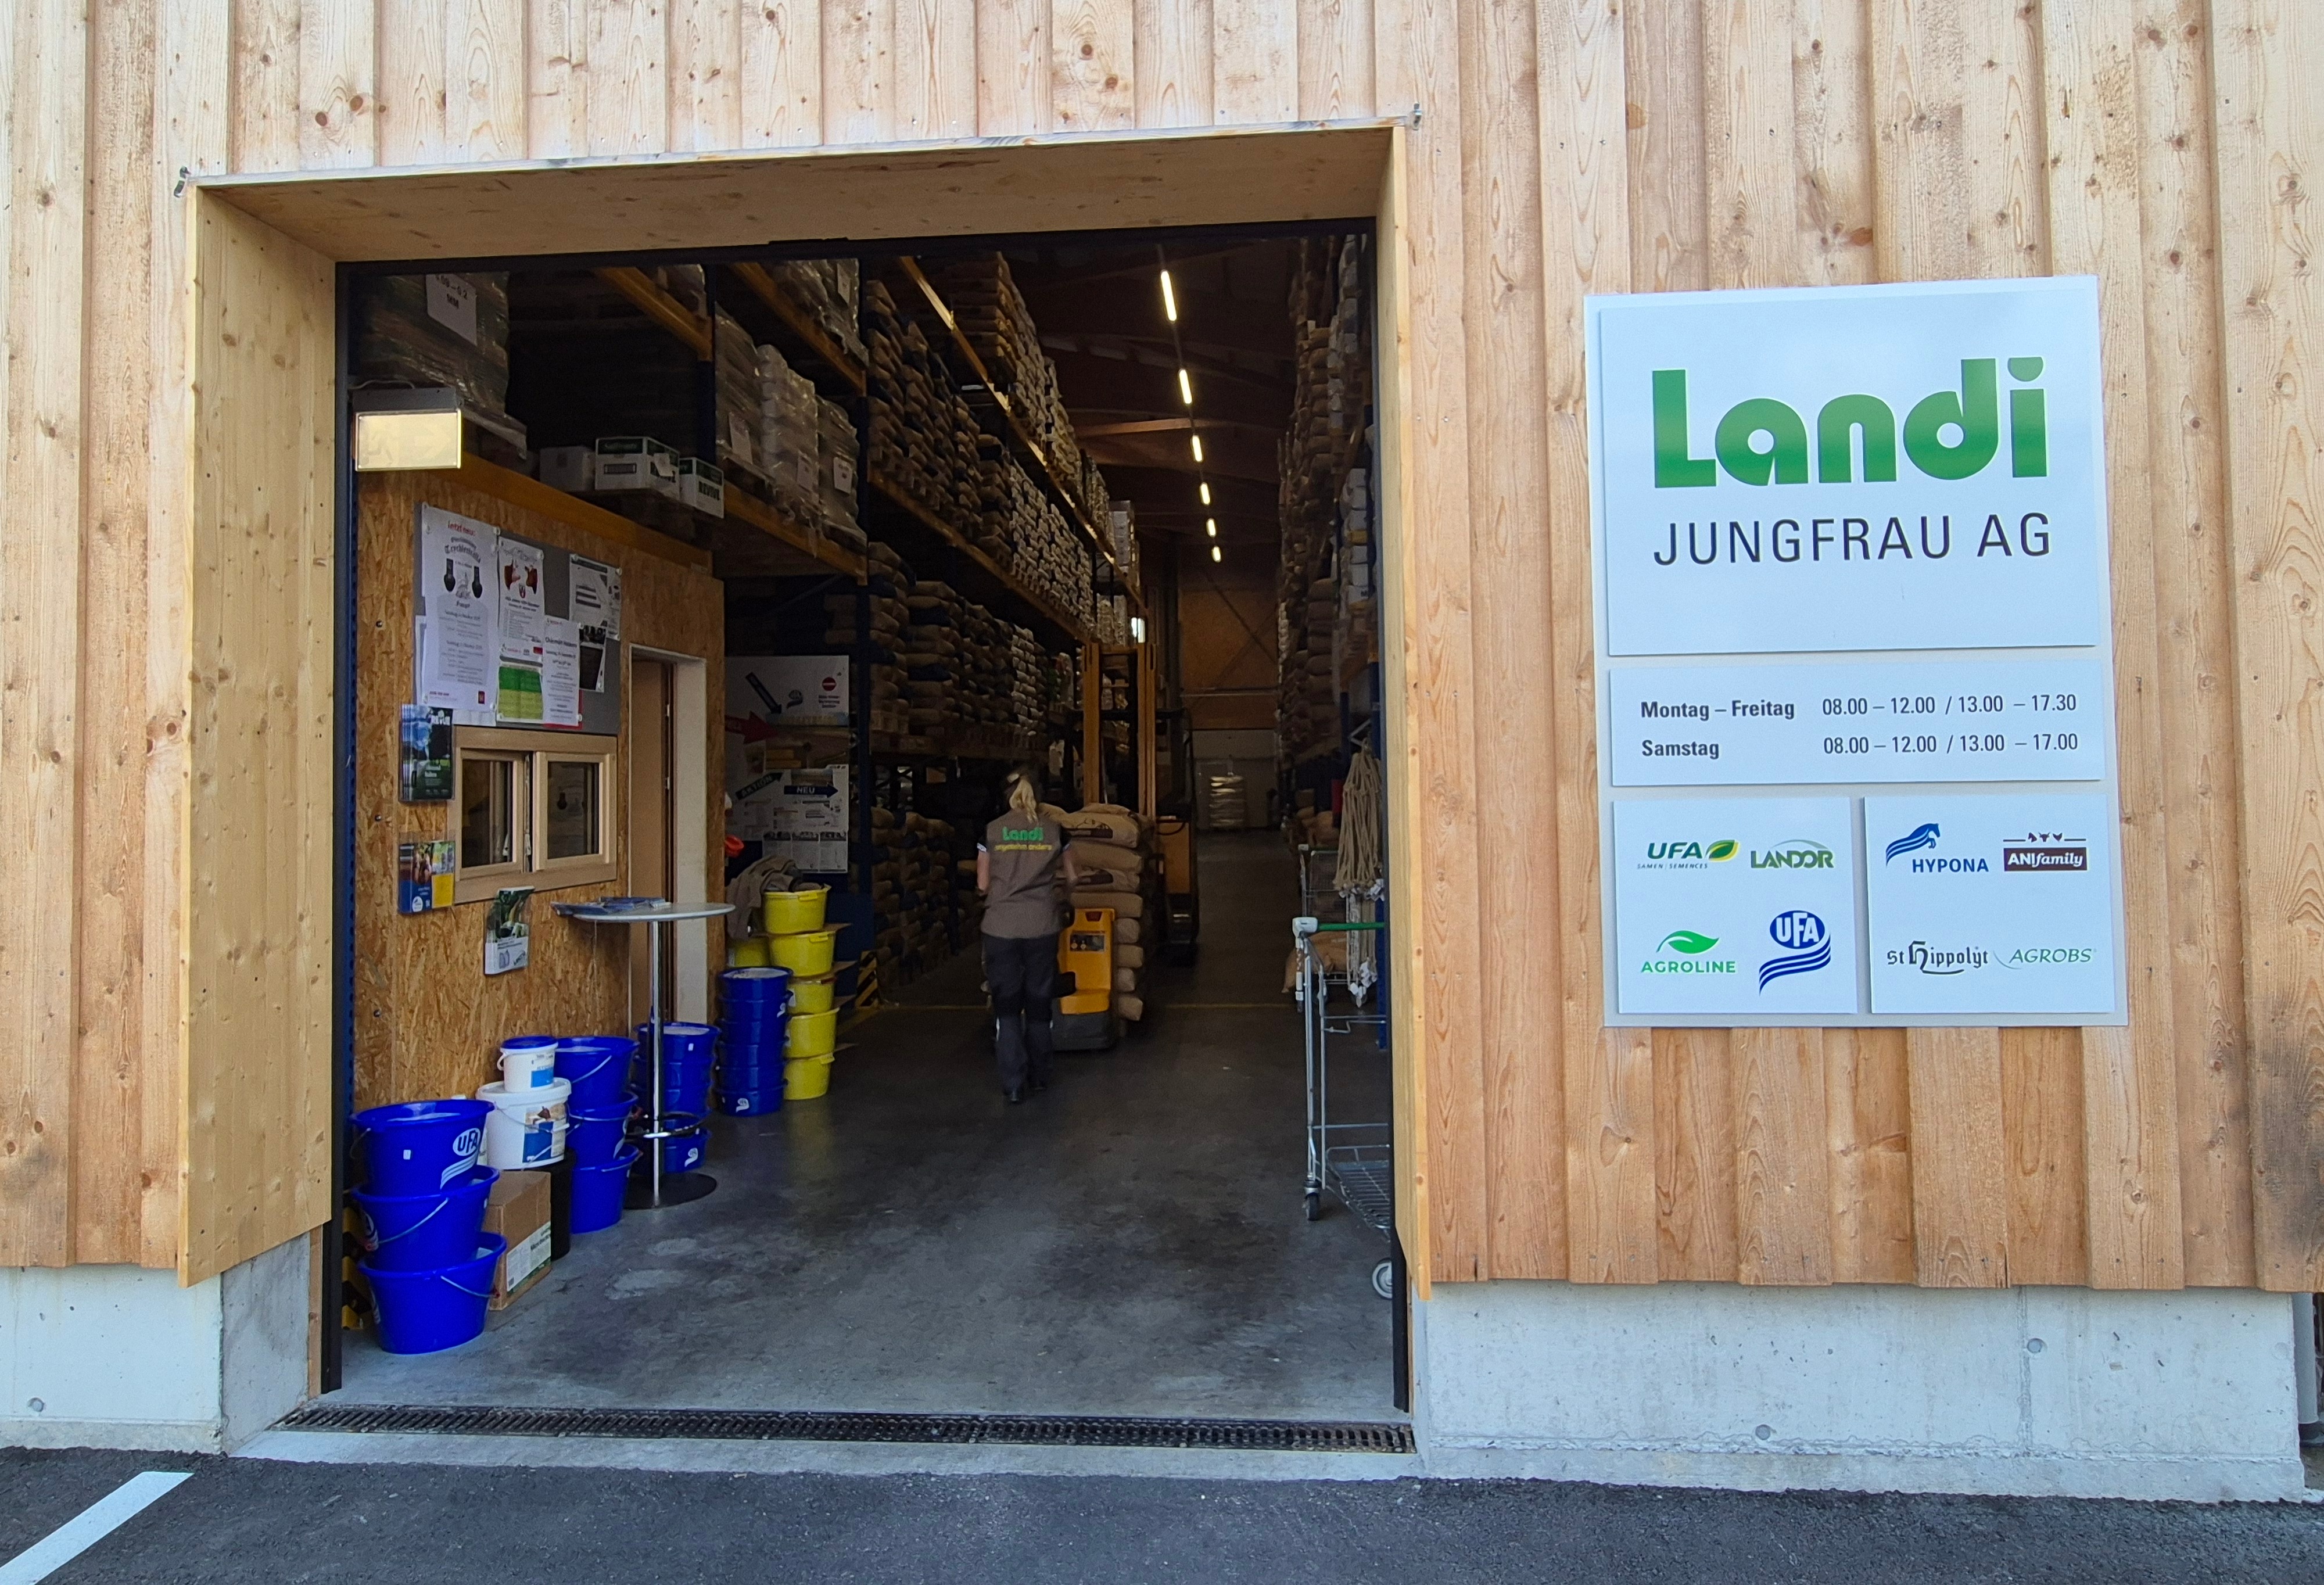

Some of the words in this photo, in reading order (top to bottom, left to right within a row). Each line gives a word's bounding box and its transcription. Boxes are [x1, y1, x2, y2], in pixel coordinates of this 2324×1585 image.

[1652, 357, 2047, 488] Landi
[1654, 515, 1950, 565] JUNGFRAU
[1977, 512, 2050, 557] AG
[1641, 701, 1709, 722] Montag
[1731, 699, 1795, 720] Freitag
[1822, 697, 1868, 715] 08.00
[1891, 696, 1935, 714] 12.00
[1958, 695, 2003, 713] 13.00
[2031, 694, 2076, 711] 17.30
[1641, 739, 1719, 760] Samstag
[1823, 736, 1869, 754] 08.00
[1892, 735, 1936, 753] 12.00
[1960, 734, 2004, 752] 13.00
[2033, 733, 2078, 751] 17.00
[796, 787, 816, 795] NEU
[1002, 826, 1044, 841] Landi
[1647, 841, 1703, 859] UFA
[1751, 850, 1834, 869] LANDOR
[1912, 858, 1989, 873] HYPONA
[2007, 852, 2083, 868] ANIfamily
[1776, 912, 1820, 947] UFA
[2009, 948, 2092, 964] AGROBS
[1640, 960, 1736, 973] AGROLINE
[457, 1129, 478, 1154] UFA
